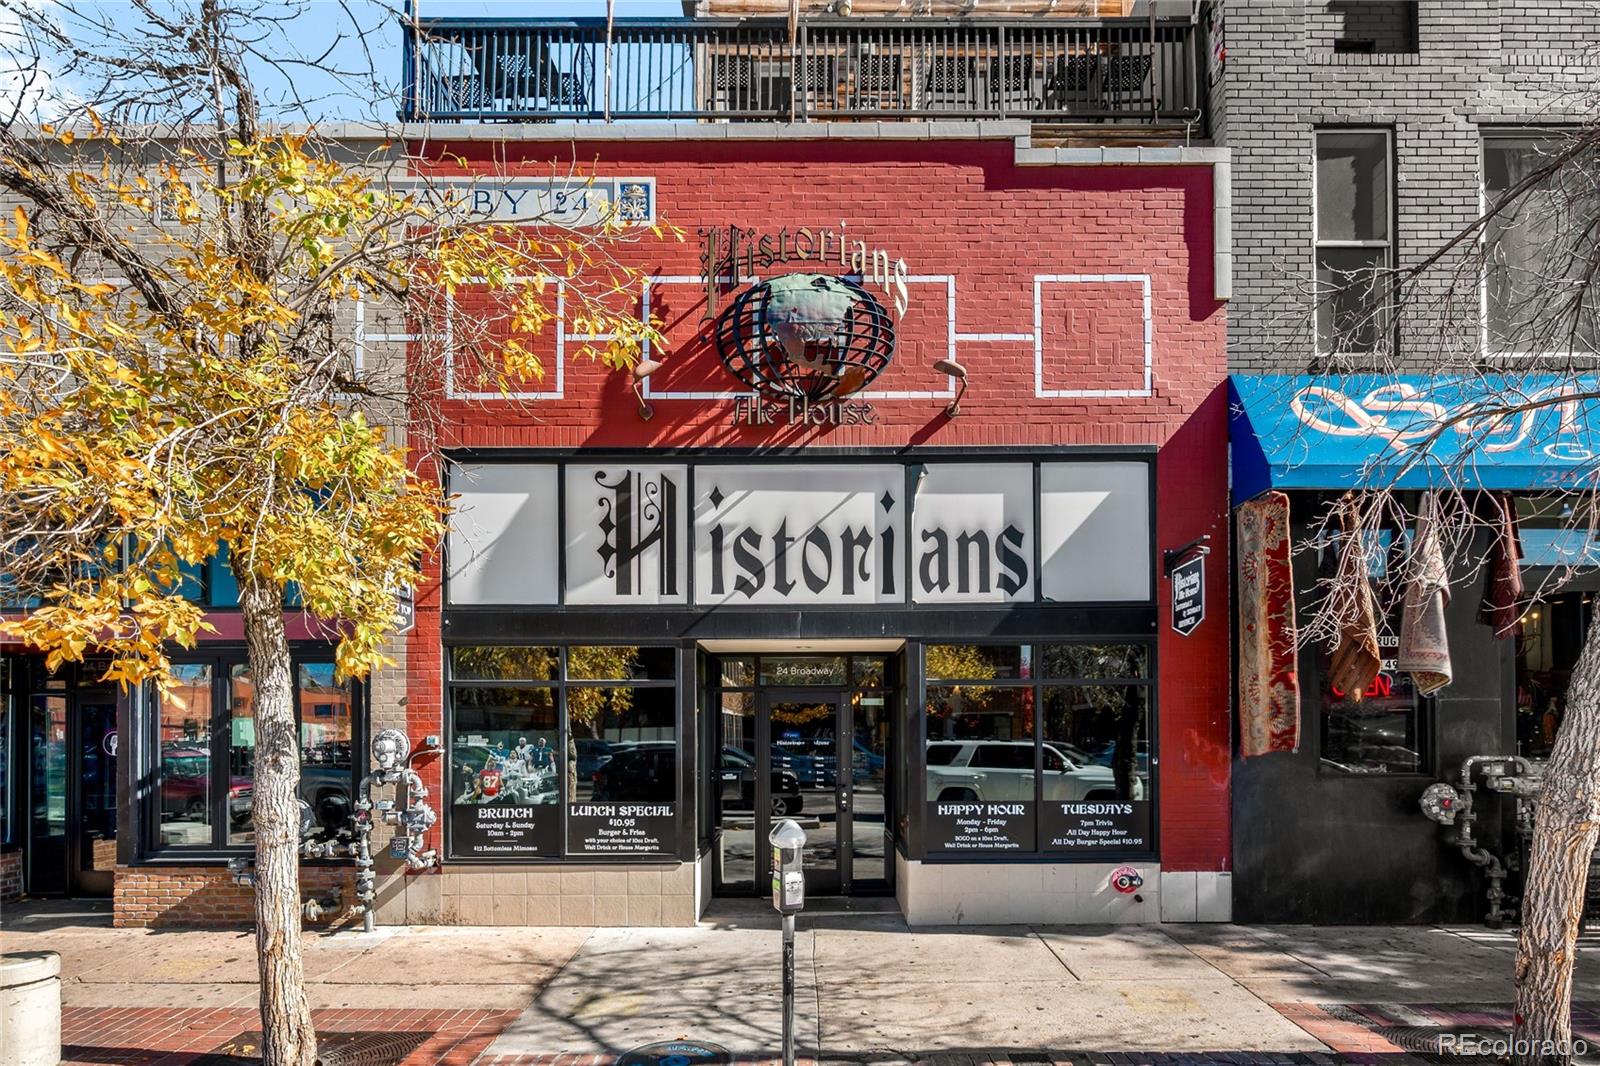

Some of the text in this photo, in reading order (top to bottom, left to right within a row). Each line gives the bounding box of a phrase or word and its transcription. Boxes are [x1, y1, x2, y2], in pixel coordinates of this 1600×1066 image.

[698, 220, 909, 343] Historians
[731, 396, 781, 425] Ale
[594, 469, 1029, 600] Historians
[776, 666, 834, 677] 24 Broadway
[483, 775, 499, 788] 87
[478, 807, 533, 819] BRUNCH
[571, 805, 674, 816] LUNCH SPECIAL
[938, 804, 1025, 815] HAPPY HOUR
[1061, 804, 1133, 814] TUESDAYS
[476, 822, 504, 830] Saturday
[512, 822, 535, 830] Sunday
[609, 818, 635, 827] $10.95
[956, 818, 981, 826] Monday
[987, 818, 1007, 826] Friday
[598, 828, 621, 837] Burger
[1078, 829, 1090, 837] Day
[1091, 829, 1110, 837] Happy
[1063, 838, 1076, 846] Day
[1076, 838, 1098, 847] Burger
[1099, 838, 1121, 846] Special
